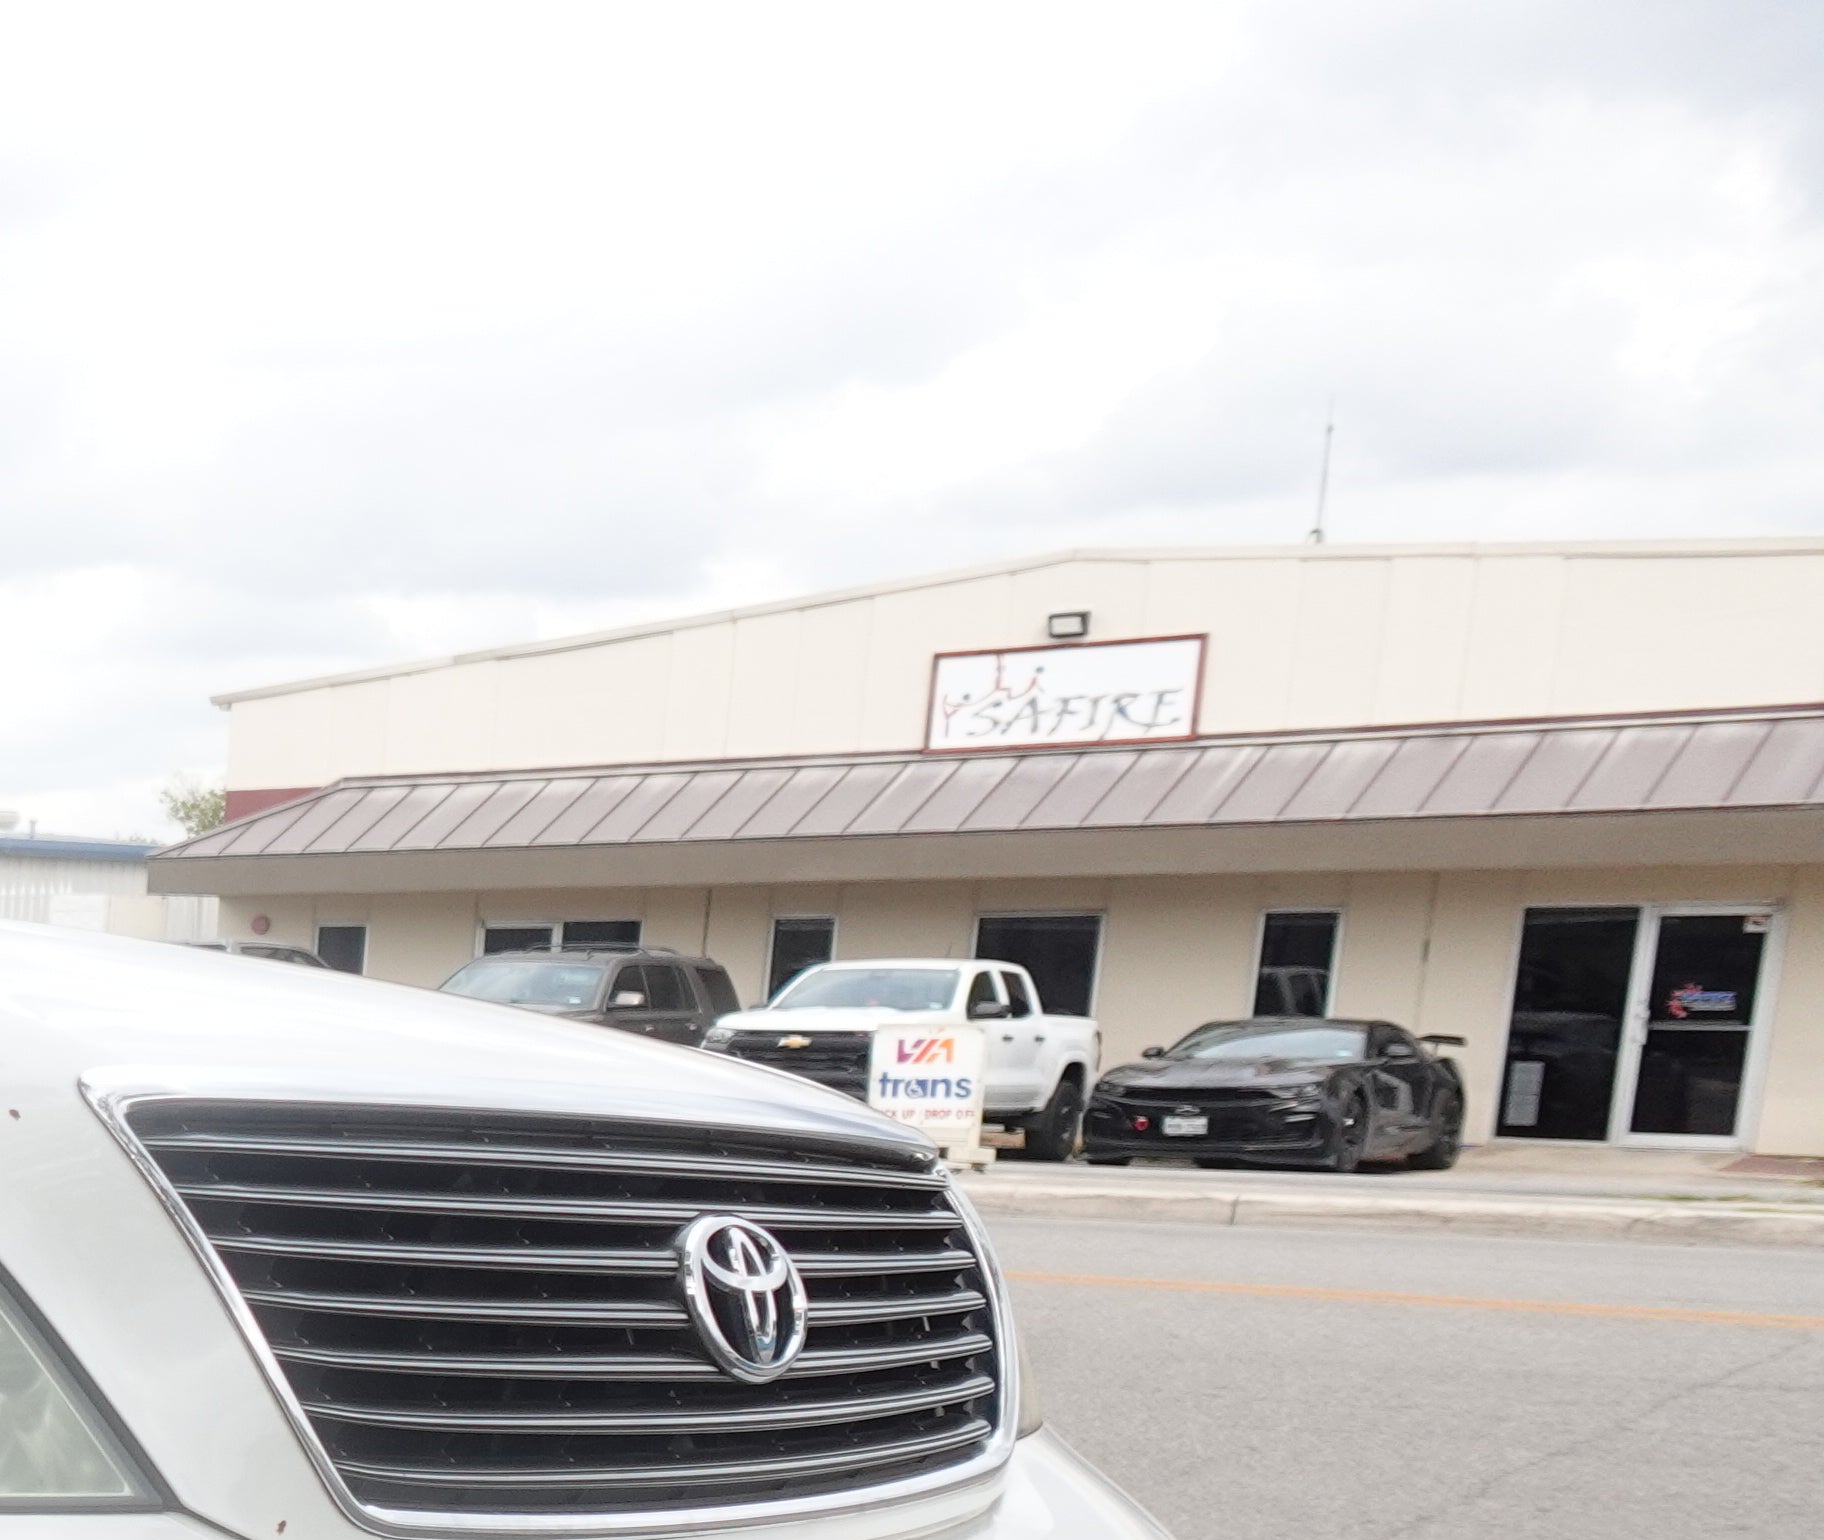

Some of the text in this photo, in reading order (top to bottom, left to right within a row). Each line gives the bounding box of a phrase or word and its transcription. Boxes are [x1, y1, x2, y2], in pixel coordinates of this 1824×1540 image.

[966, 688, 1184, 741] SAFIRE
[896, 1038, 954, 1063] VIA
[878, 1072, 972, 1099] trans
